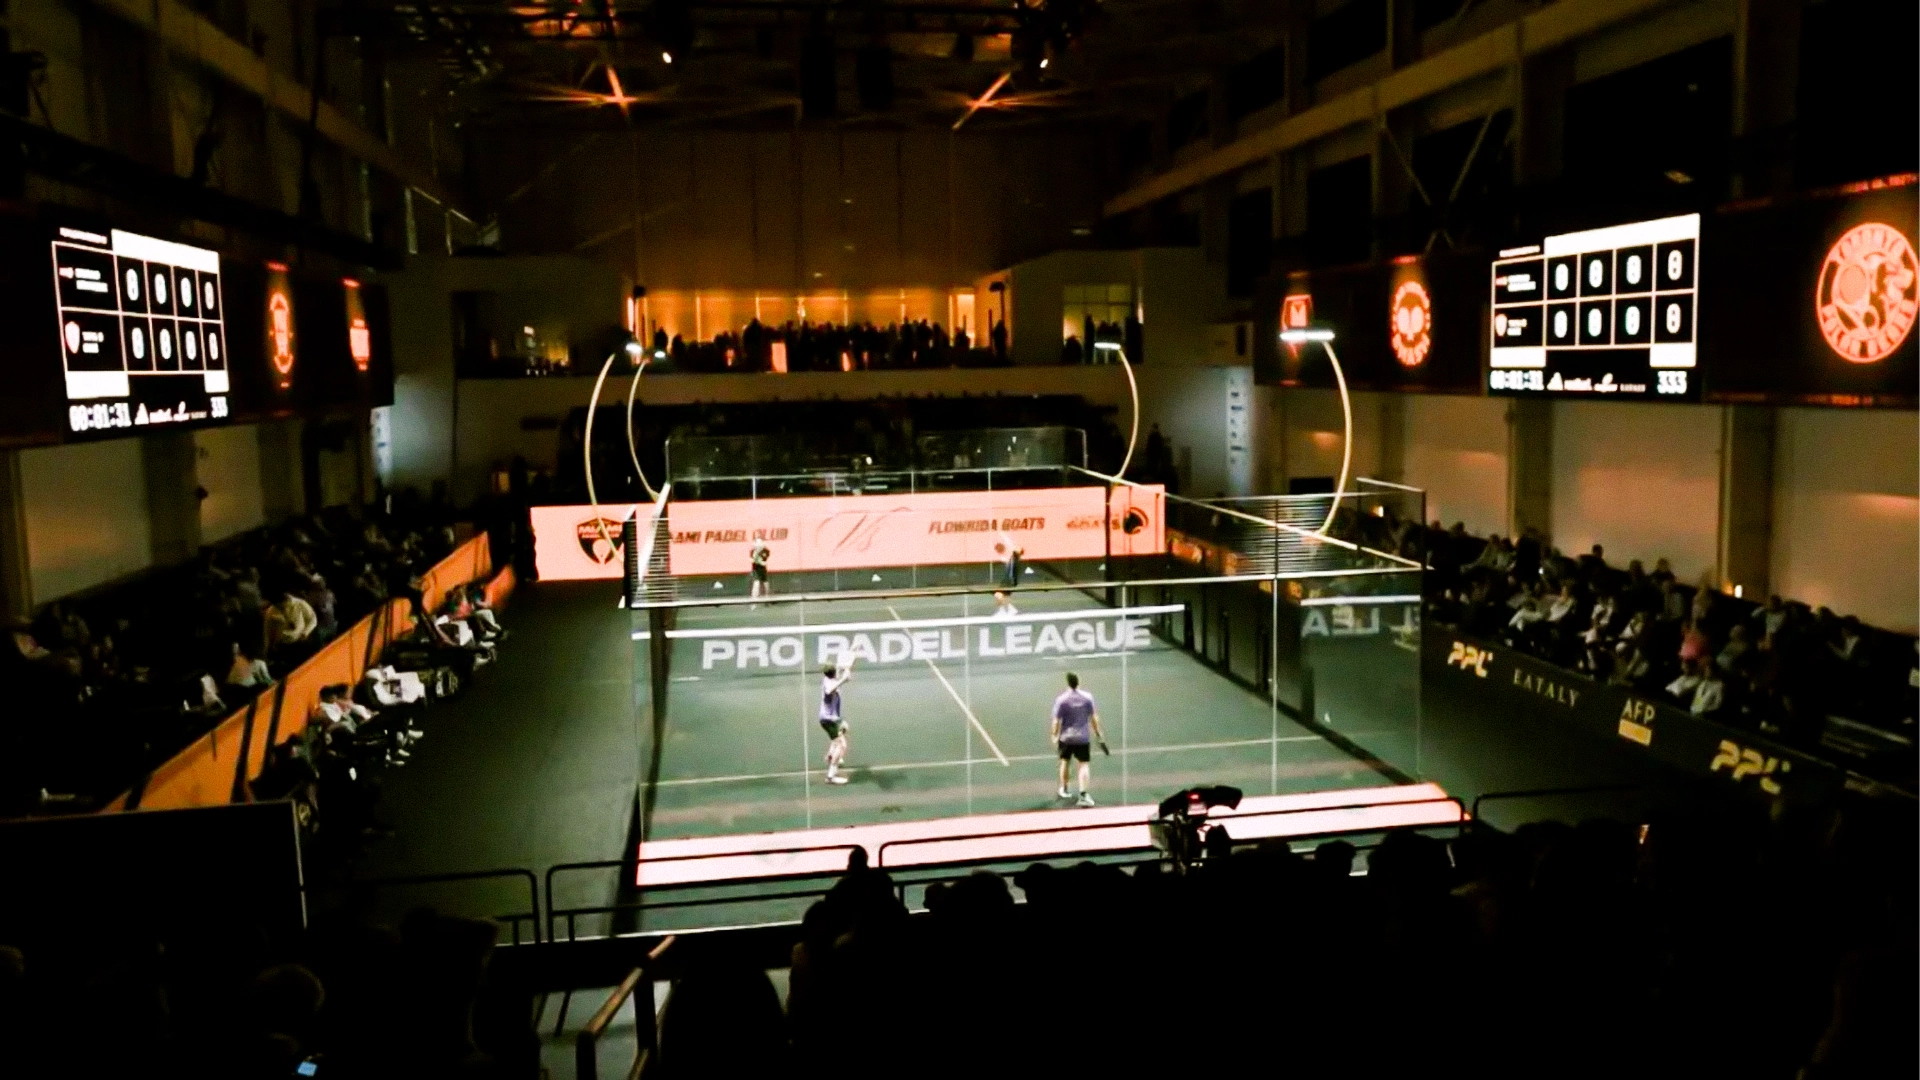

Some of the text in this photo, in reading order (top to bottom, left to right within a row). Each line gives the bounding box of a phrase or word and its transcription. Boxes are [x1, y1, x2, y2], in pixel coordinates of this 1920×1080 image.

[704, 529, 748, 544] PADEL
[702, 618, 1151, 670] PRO PADEL LEAGUE
[1513, 668, 1580, 708] EATALY
[1621, 698, 1656, 724] AFP
